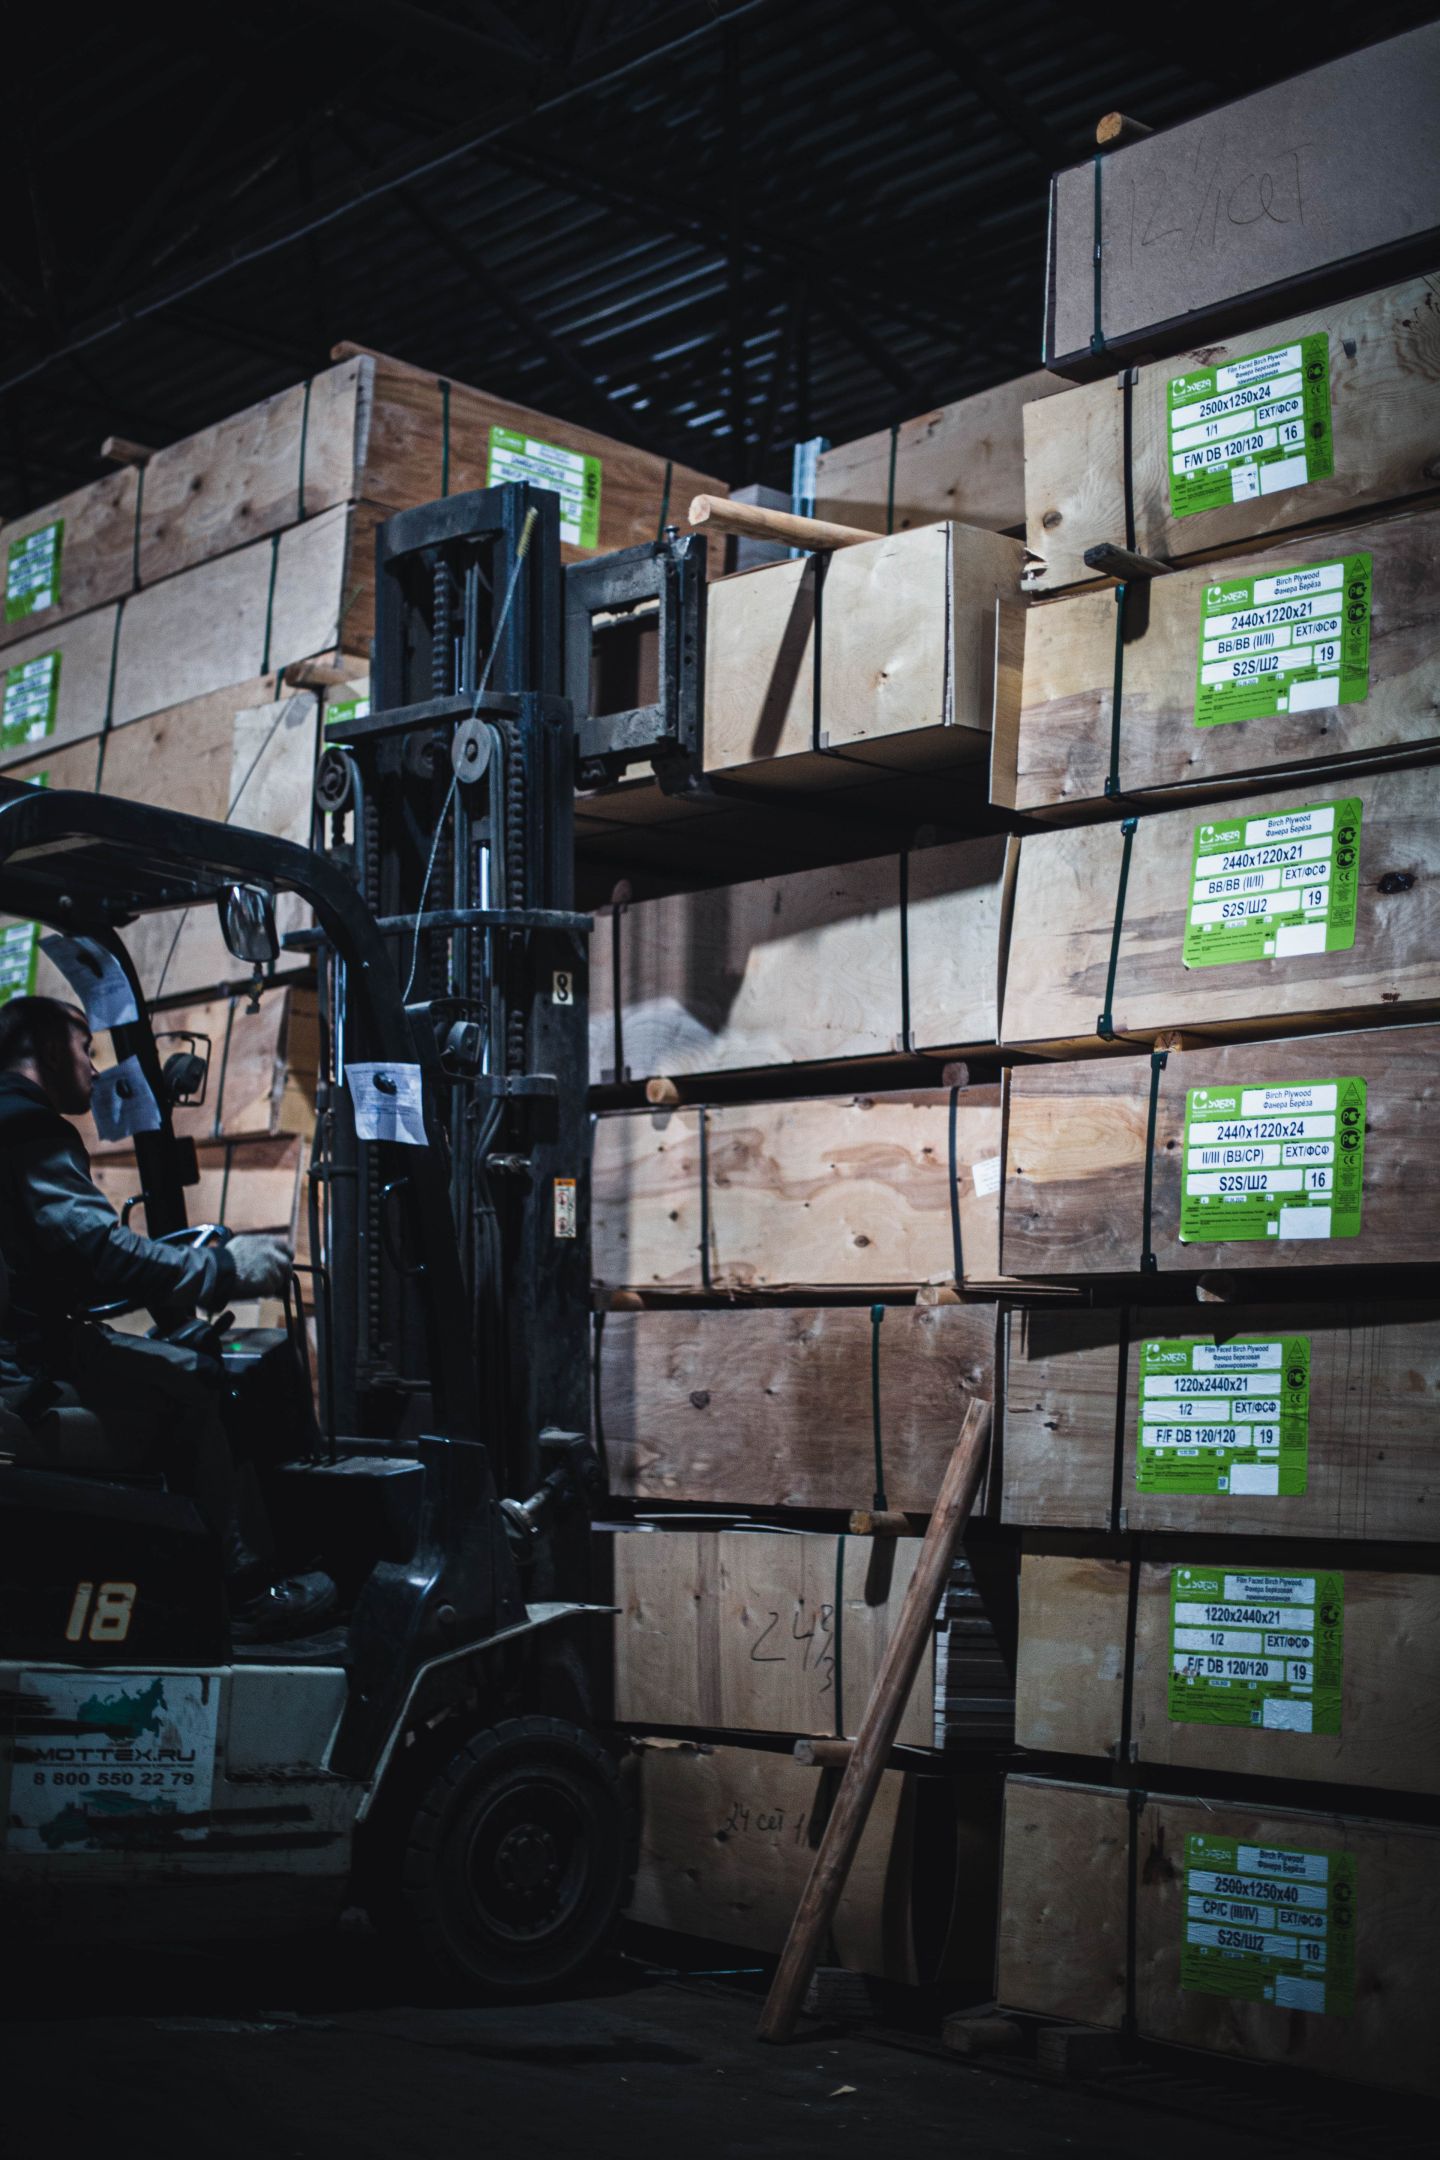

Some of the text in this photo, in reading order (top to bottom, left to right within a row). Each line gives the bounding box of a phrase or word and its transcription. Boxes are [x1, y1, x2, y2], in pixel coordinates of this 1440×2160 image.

[1254, 358, 1266, 366] Birch
[1267, 350, 1288, 361] Plywood
[1200, 385, 1271, 417] 2500x1250x24
[1206, 424, 1218, 437] 1/1
[1285, 426, 1298, 440] 16
[1184, 453, 1203, 469] F/W
[1207, 447, 1222, 462] DB
[1225, 435, 1264, 457] 120/120
[1276, 571, 1320, 587] Birch Plywood
[1274, 585, 1298, 596] Фанера
[1231, 602, 1313, 630] 2440x1220x21
[1218, 637, 1250, 654] BB/BB
[1320, 645, 1334, 661] 19
[1232, 656, 1279, 677] S2S/Ш2
[1268, 814, 1311, 827] Birch Plywood
[1266, 827, 1289, 837] Фанера
[1222, 845, 1303, 871] 2440x1220x21
[1208, 878, 1240, 894] BB/BB
[1308, 890, 1322, 906] 19
[1222, 898, 1268, 918] S2S/Ш2
[1265, 1089, 1312, 1100] Birch Plywood
[1263, 1100, 1288, 1110] Фанера
[1217, 1121, 1305, 1141] 2440x1220x24
[1223, 1148, 1264, 1165] (BB/CP)
[1219, 1175, 1268, 1191] S2S/Ш2
[1311, 1172, 1326, 1188] 16
[1248, 1345, 1269, 1354] Plywood
[1213, 1354, 1232, 1362] Фанера
[1174, 1377, 1248, 1392] 1220x2440x21
[1179, 1403, 1192, 1416] 1/2
[1156, 1429, 1236, 1443] F/F DB 120/120
[1260, 1429, 1273, 1444] 19
[65, 1581, 137, 1642] 18
[1205, 1608, 1280, 1625] 1220x2440x21
[1210, 1633, 1224, 1646] 1/2
[1187, 1657, 1268, 1676] F/F DB 120/120
[1293, 1664, 1307, 1680] 19
[35, 1748, 195, 1762] MOTTEX.RU
[33, 1772, 194, 1786] 8 800 550 22 79
[1215, 1877, 1298, 1903] 2500x1250x40
[1203, 1900, 1227, 1916] CP/C
[1218, 1929, 1265, 1951] S2S/Ш2
